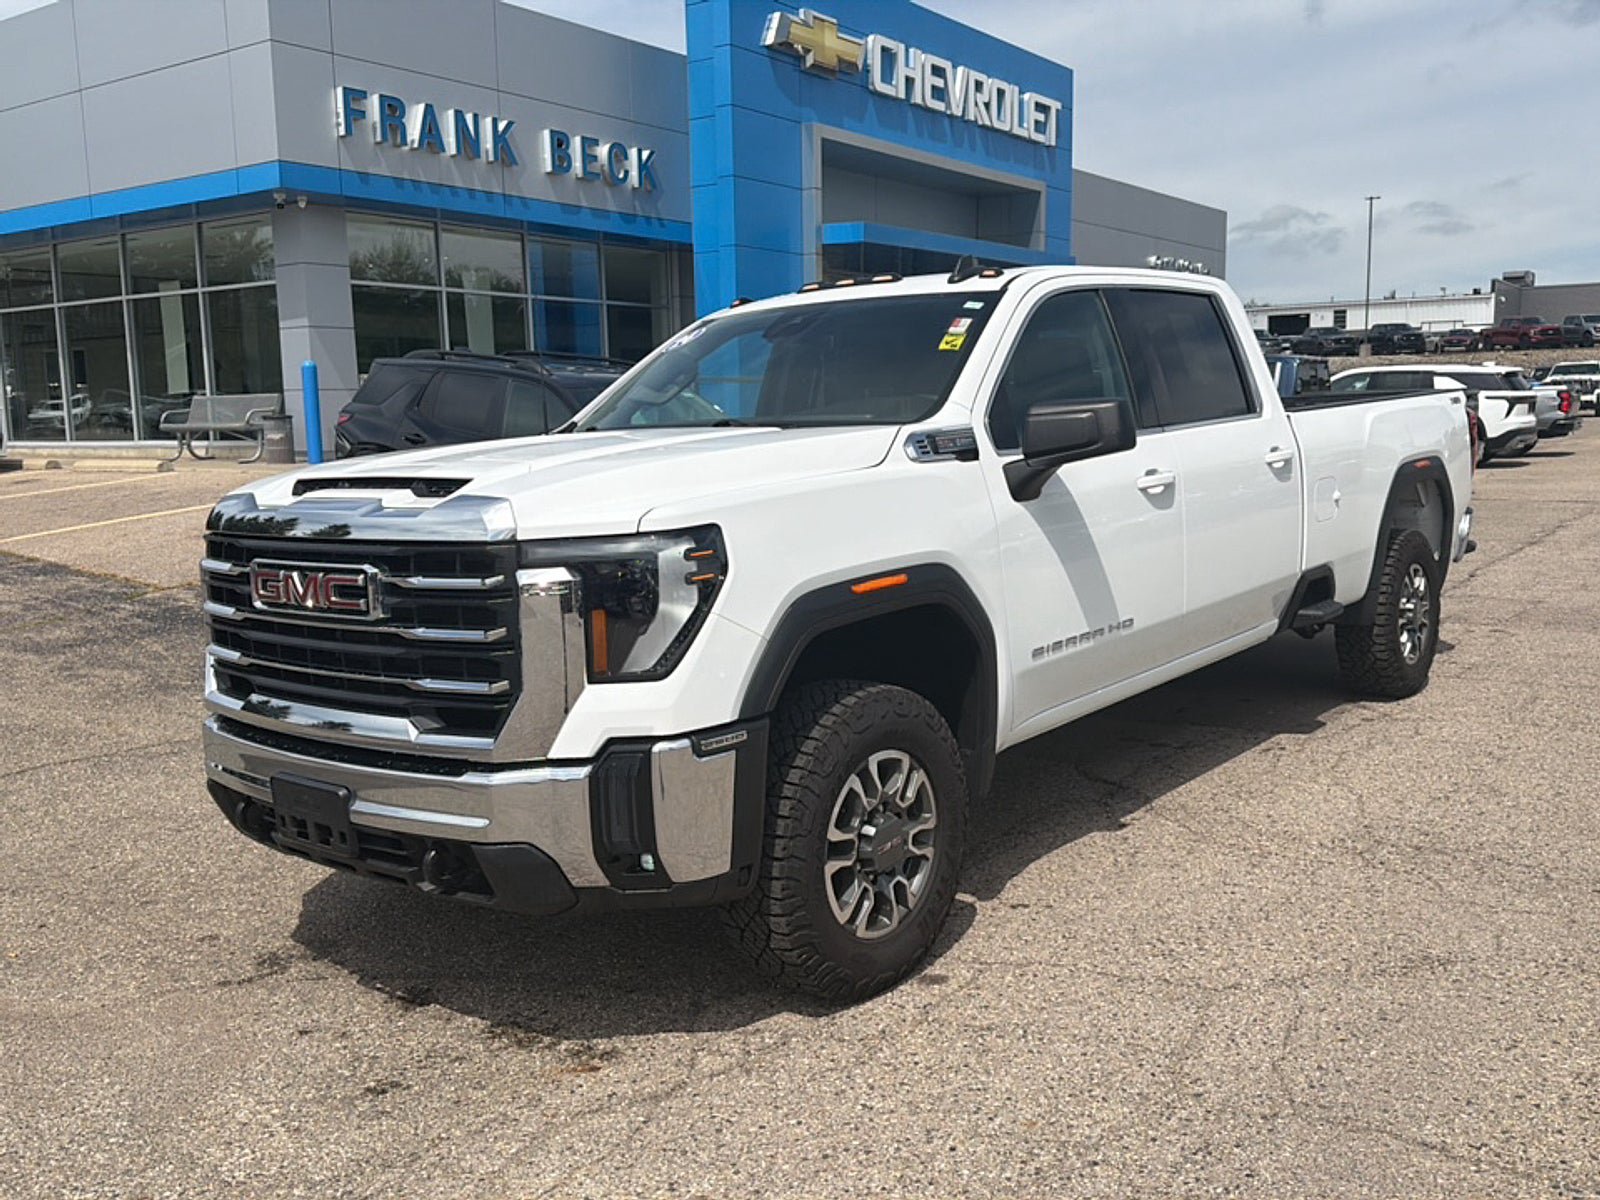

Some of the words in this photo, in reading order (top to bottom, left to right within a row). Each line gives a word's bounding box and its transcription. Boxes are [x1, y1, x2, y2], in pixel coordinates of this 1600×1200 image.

[866, 34, 1062, 147] CHEVROLET
[337, 86, 520, 167] FRANK
[543, 127, 658, 191] BECK
[255, 569, 368, 611] GMC
[1031, 627, 1105, 661] SIERRA
[1108, 617, 1135, 634] HD
